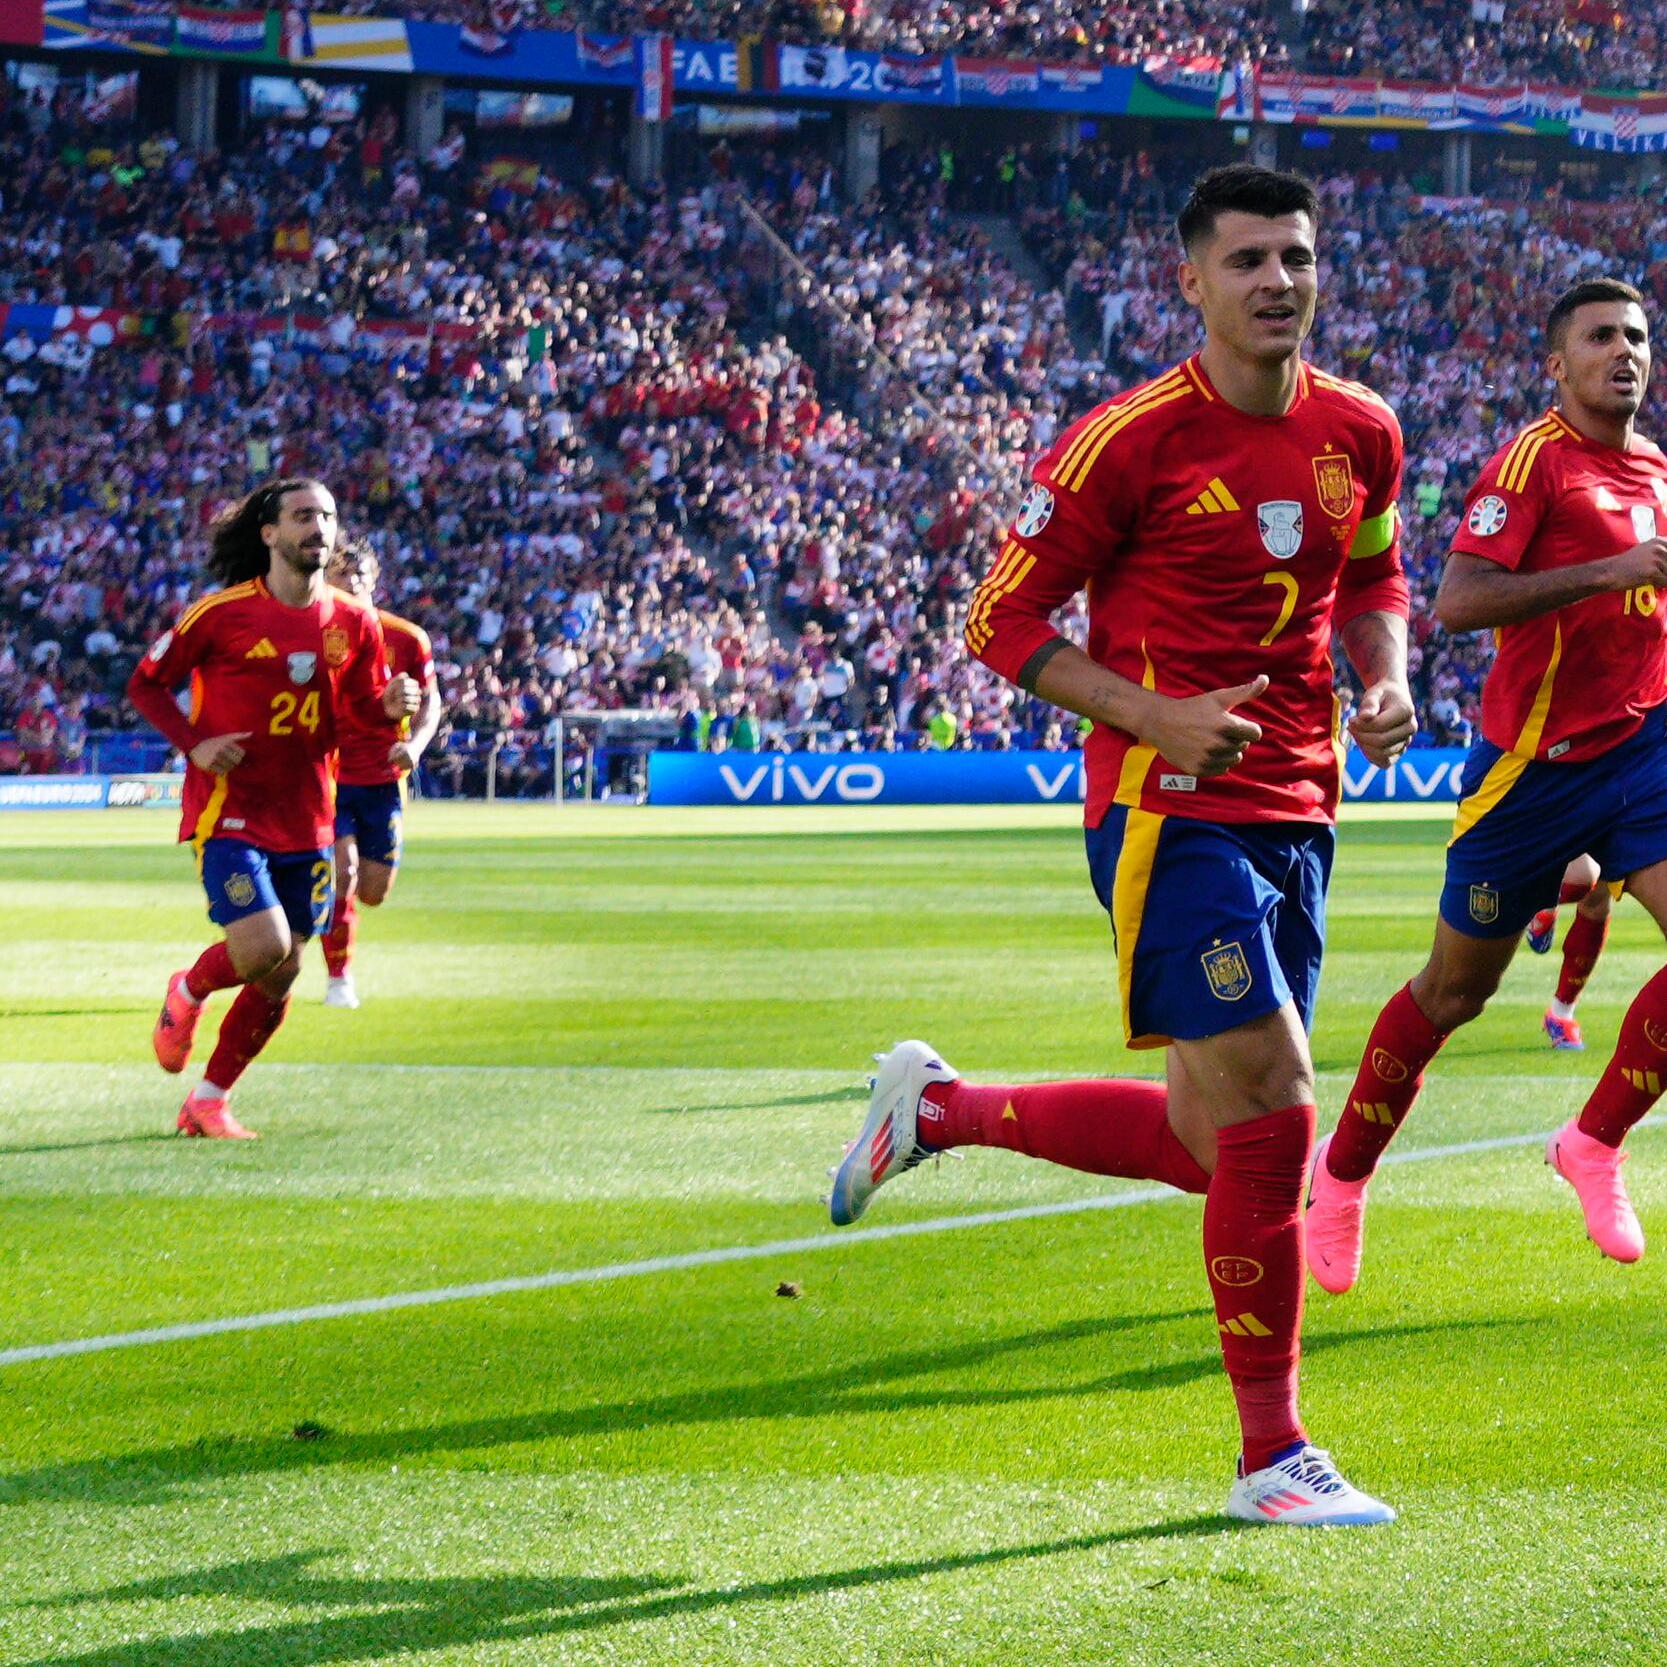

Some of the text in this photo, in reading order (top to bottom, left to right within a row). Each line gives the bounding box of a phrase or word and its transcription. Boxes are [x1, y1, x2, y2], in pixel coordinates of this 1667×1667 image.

[1263, 571, 1299, 647] 7
[269, 690, 320, 736] 24
[720, 757, 885, 801] vivo
